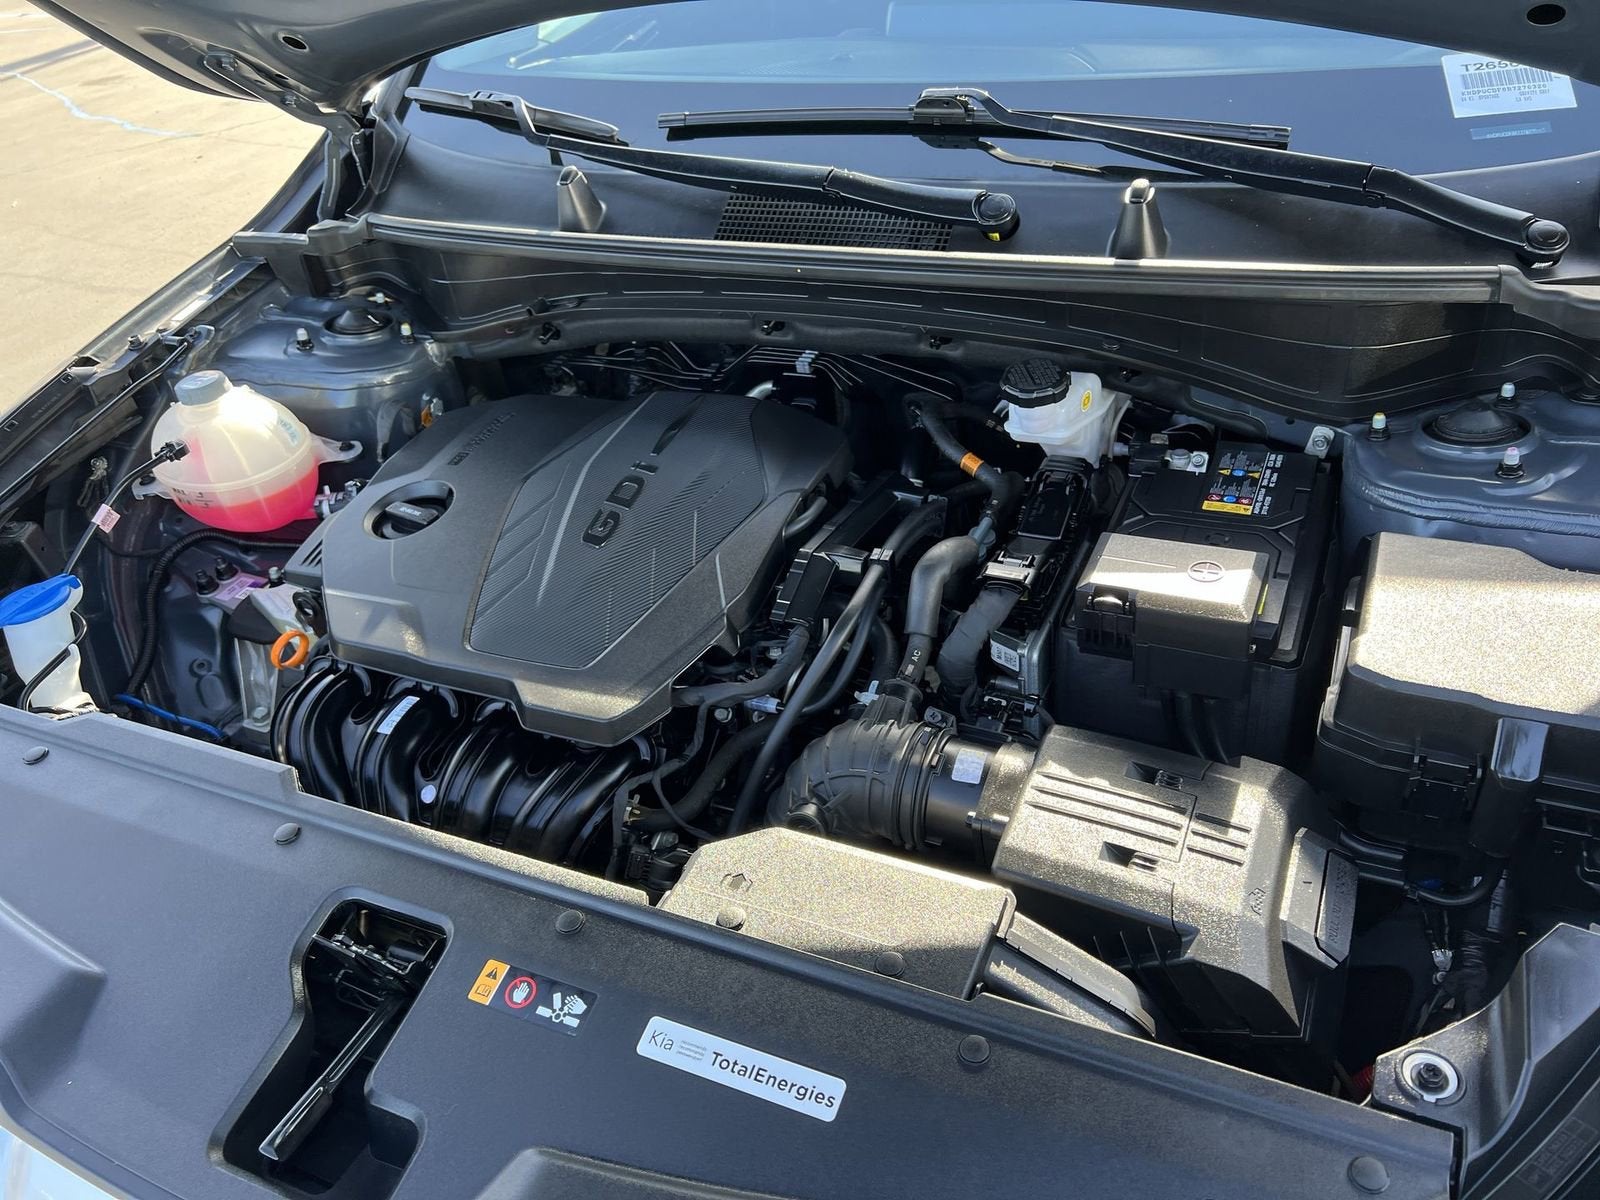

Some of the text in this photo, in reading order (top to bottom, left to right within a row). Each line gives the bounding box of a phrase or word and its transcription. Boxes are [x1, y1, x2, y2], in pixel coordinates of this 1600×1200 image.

[912, 649, 921, 662] AC
[648, 1030, 674, 1051] Kia
[710, 1051, 836, 1109] TotalEnergies
